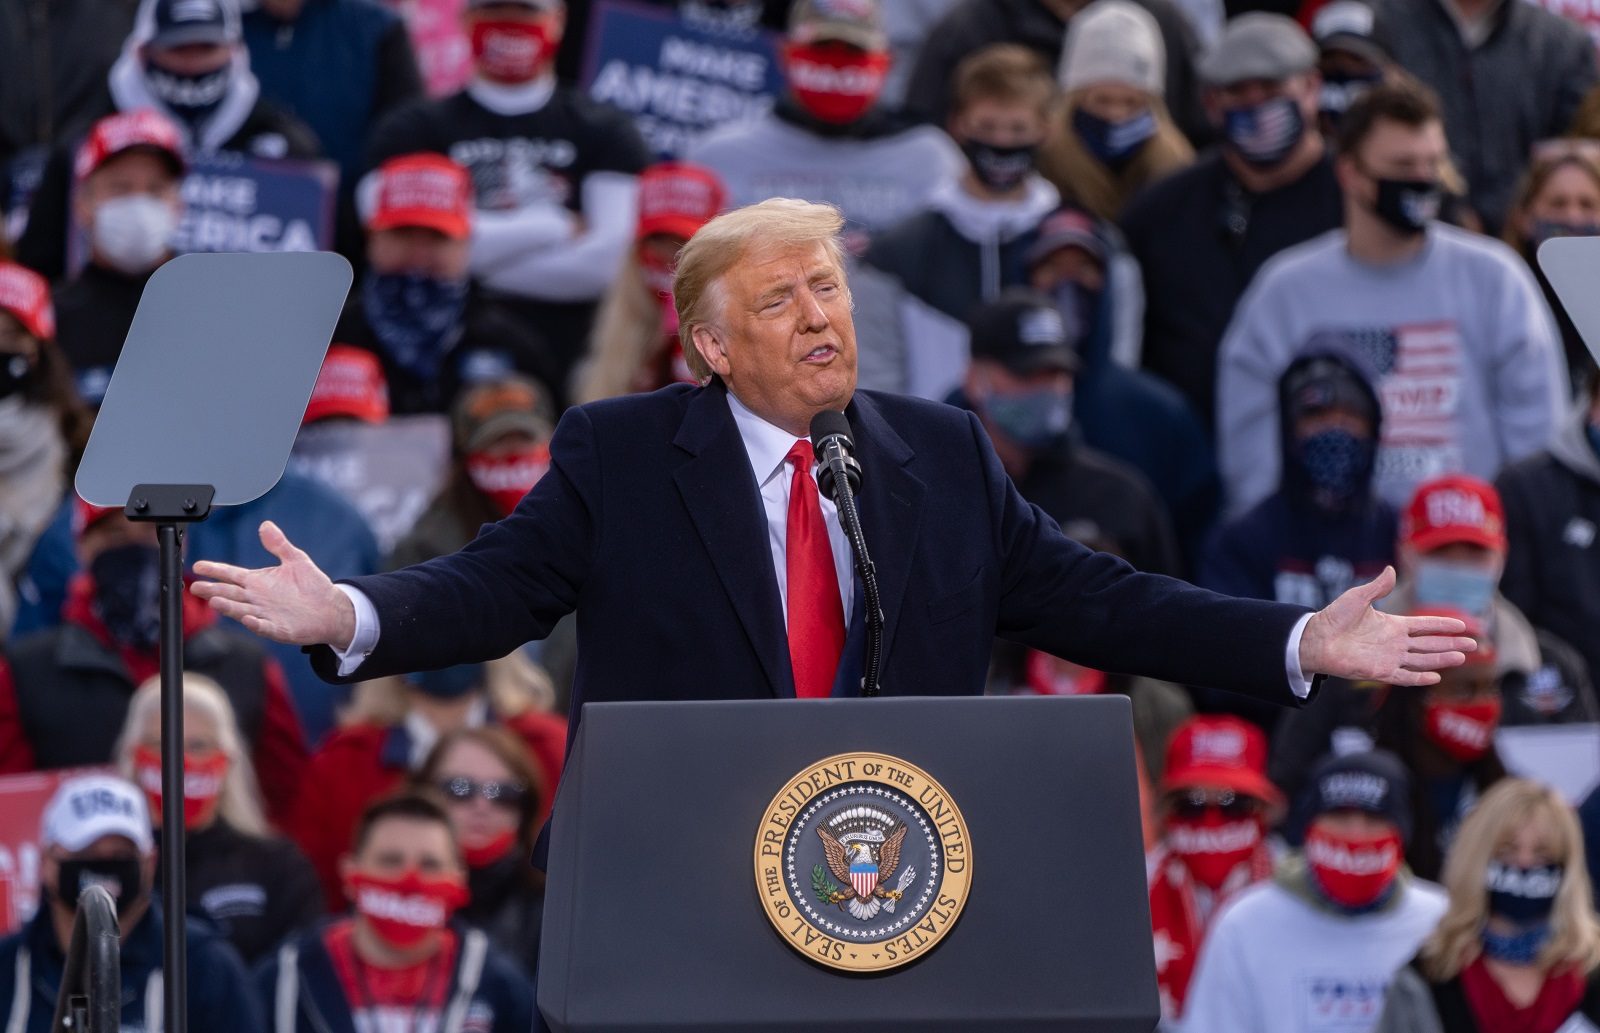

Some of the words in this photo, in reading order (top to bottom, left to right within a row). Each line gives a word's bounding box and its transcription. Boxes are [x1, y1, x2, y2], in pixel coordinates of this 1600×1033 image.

[1425, 490, 1486, 529] USA
[863, 763, 883, 776] OF
[887, 767, 914, 788] THE
[762, 761, 856, 858] PRESIDENT
[919, 785, 965, 873] UNITED
[765, 866, 781, 897] THE
[773, 900, 791, 918] OF
[884, 894, 957, 961] STATES
[791, 916, 846, 961] SEAL
